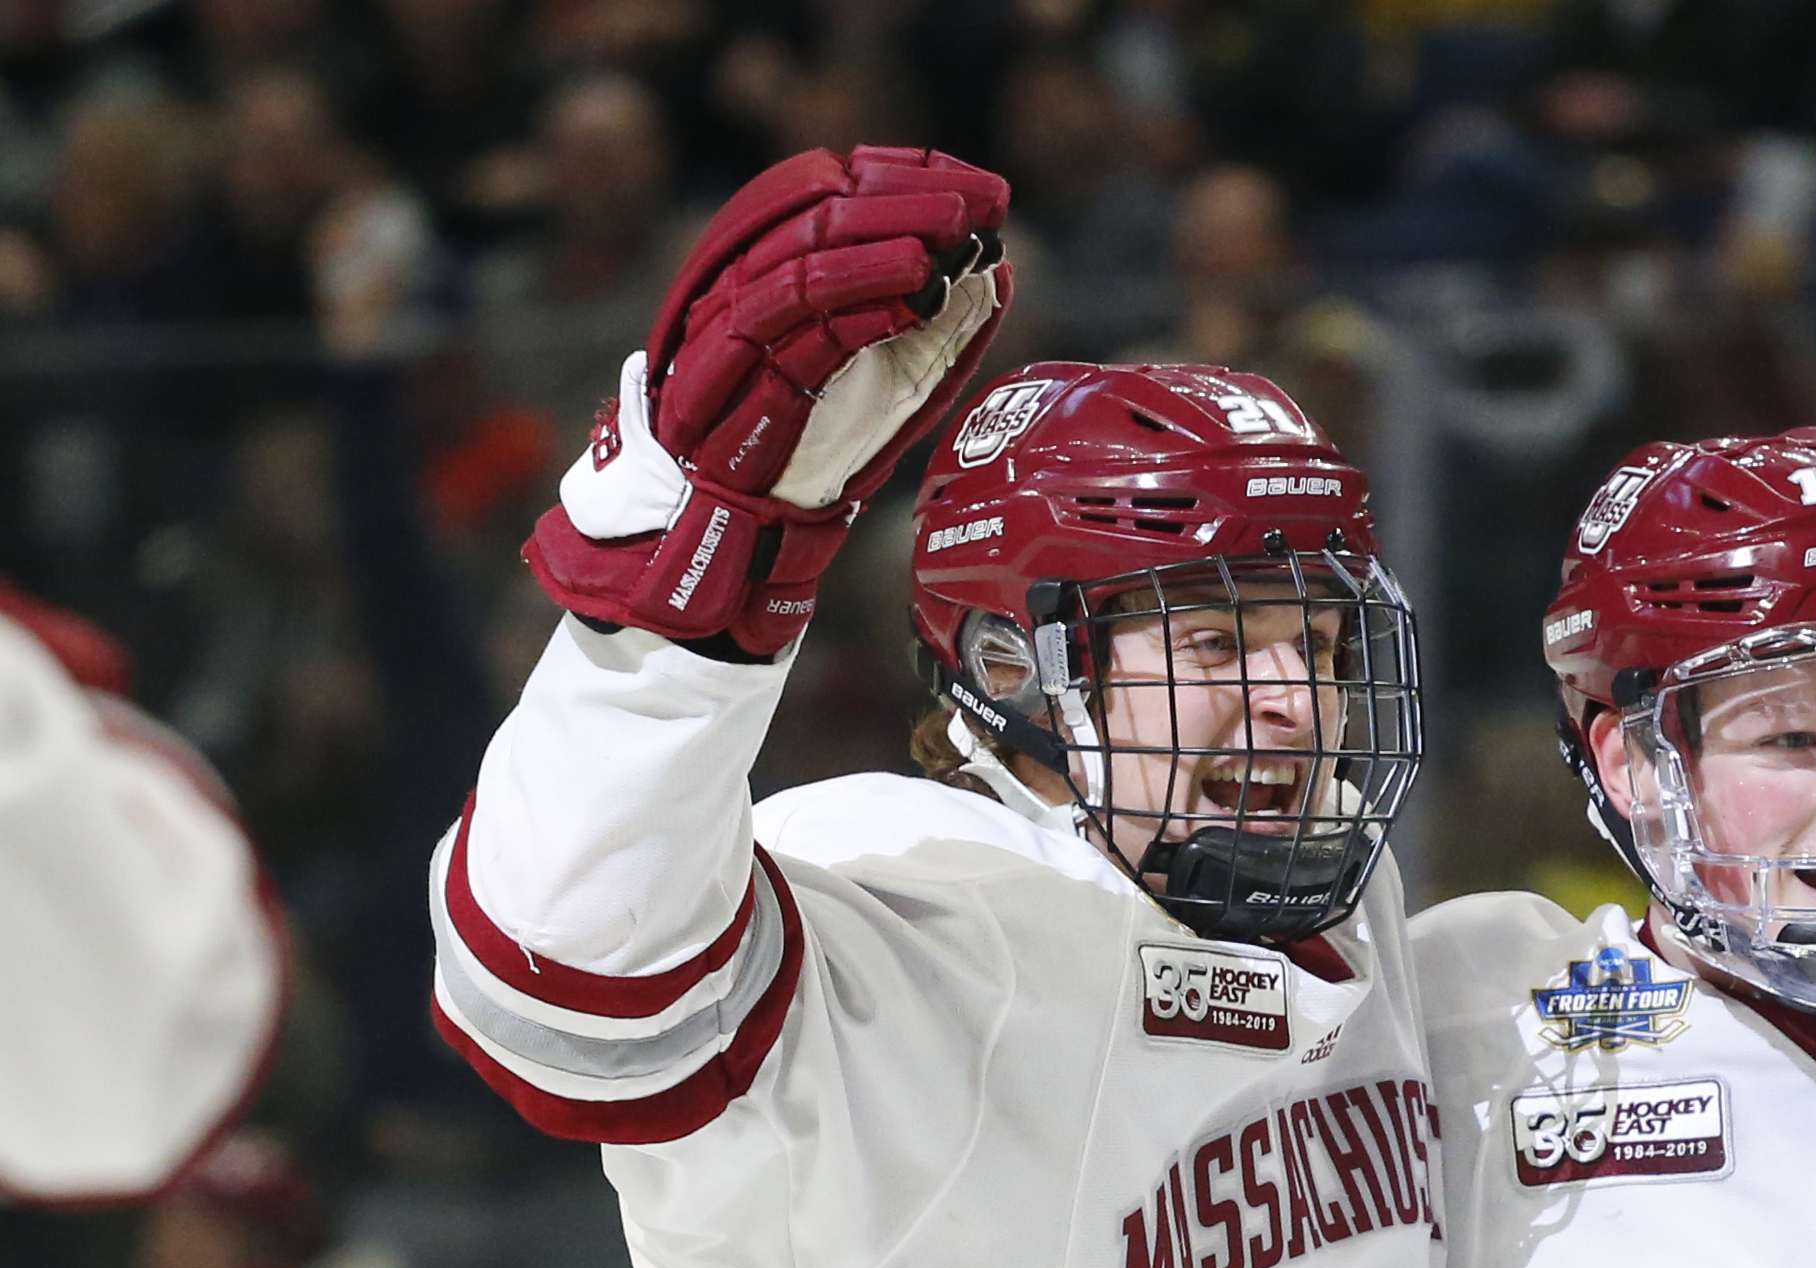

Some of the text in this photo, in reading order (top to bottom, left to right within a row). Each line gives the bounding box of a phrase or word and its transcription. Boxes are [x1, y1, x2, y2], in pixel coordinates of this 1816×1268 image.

[1217, 394, 1305, 435] 21
[1247, 477, 1343, 498] BAUER
[927, 516, 1004, 553] BAUER
[668, 506, 730, 611] MASSACHUSETTS
[1545, 609, 1593, 645] BAUER
[951, 681, 1007, 732] BAUER
[1211, 966, 1279, 991] HOCKEY
[1210, 984, 1250, 1005] EAST
[1547, 991, 1624, 1013] FROZEN
[1627, 988, 1679, 1010] FOUR
[1211, 1010, 1276, 1032] 1984-2019
[1615, 1095, 1714, 1121] HOCKEY
[1613, 1117, 1672, 1137] EAST
[1613, 1141, 1708, 1161] 1984-2019
